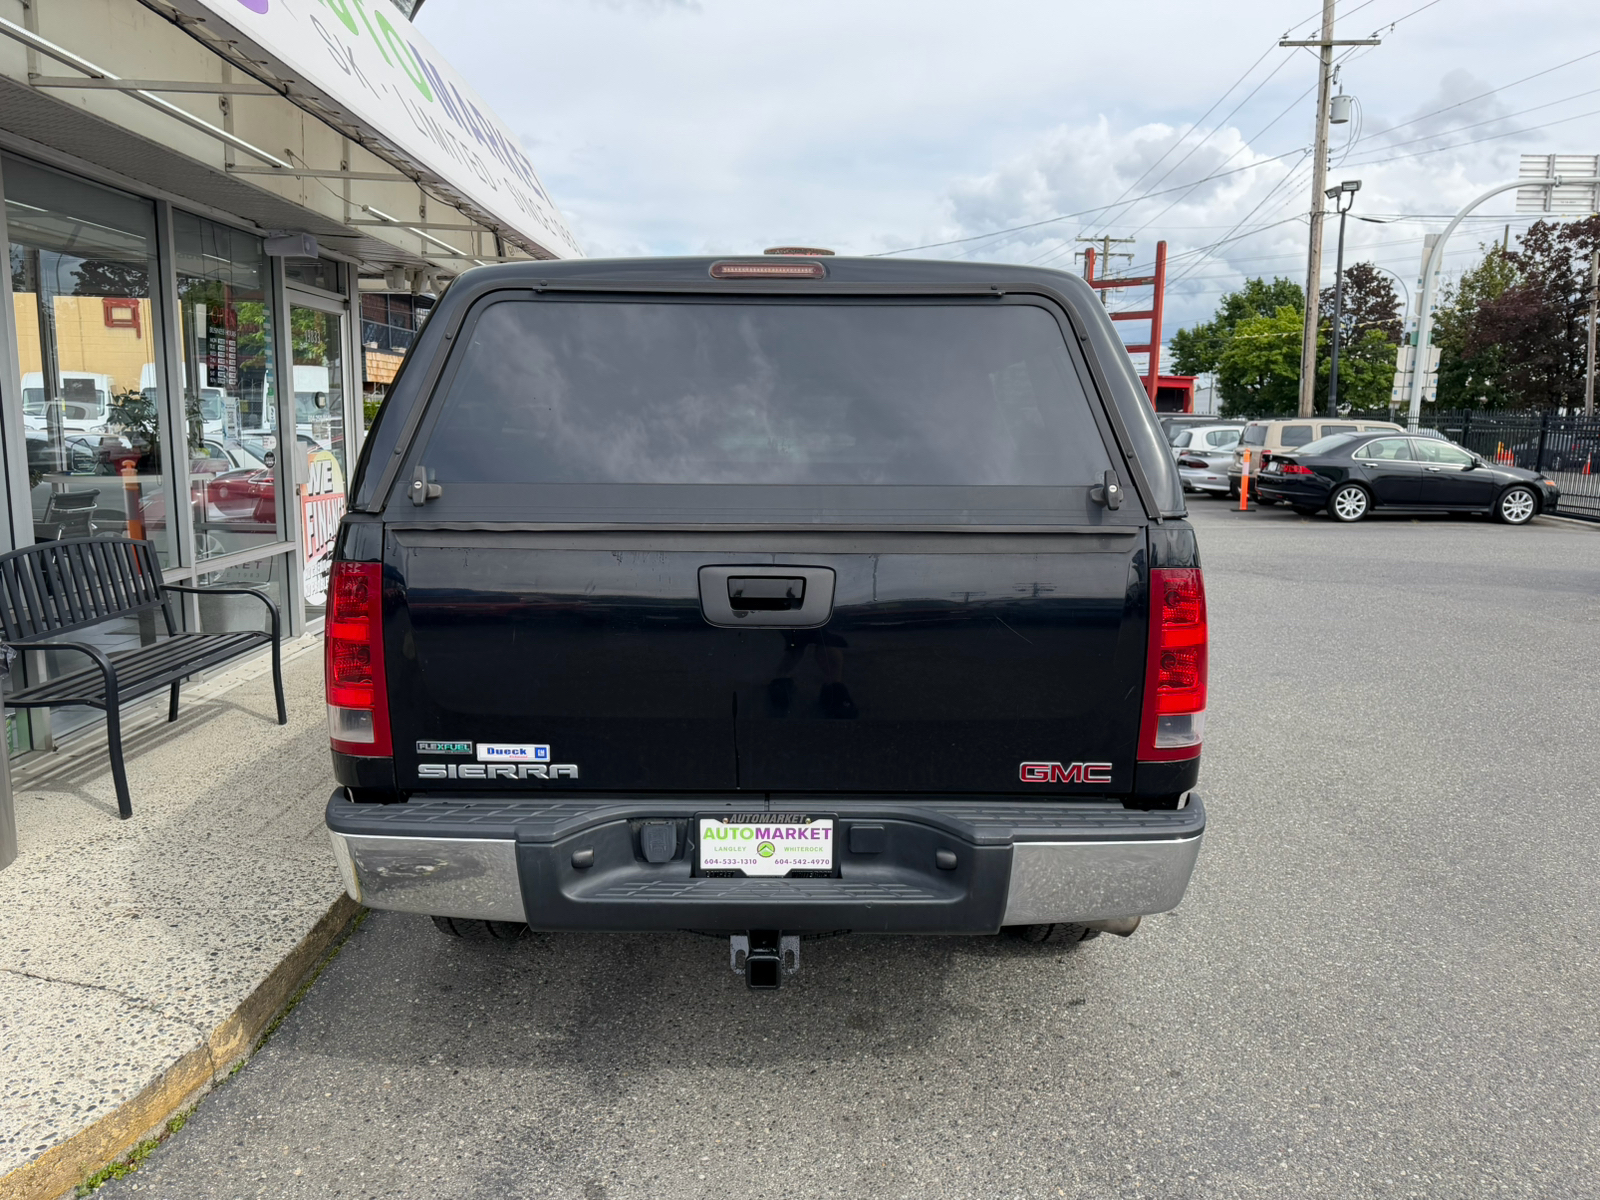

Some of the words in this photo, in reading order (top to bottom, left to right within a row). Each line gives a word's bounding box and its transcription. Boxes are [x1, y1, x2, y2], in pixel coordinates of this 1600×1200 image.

[310, 14, 381, 100] SK
[392, 84, 498, 192] LIMITED
[308, 459, 334, 496] WE
[419, 743, 470, 751] FLEXFUEL
[487, 747, 527, 755] Dueck
[418, 764, 579, 779] SIERRA
[1019, 761, 1113, 783] GMC
[729, 814, 806, 824] AUTOMARKET
[703, 827, 832, 840] AUTOMARKET
[705, 870, 736, 878] LANGLEY
